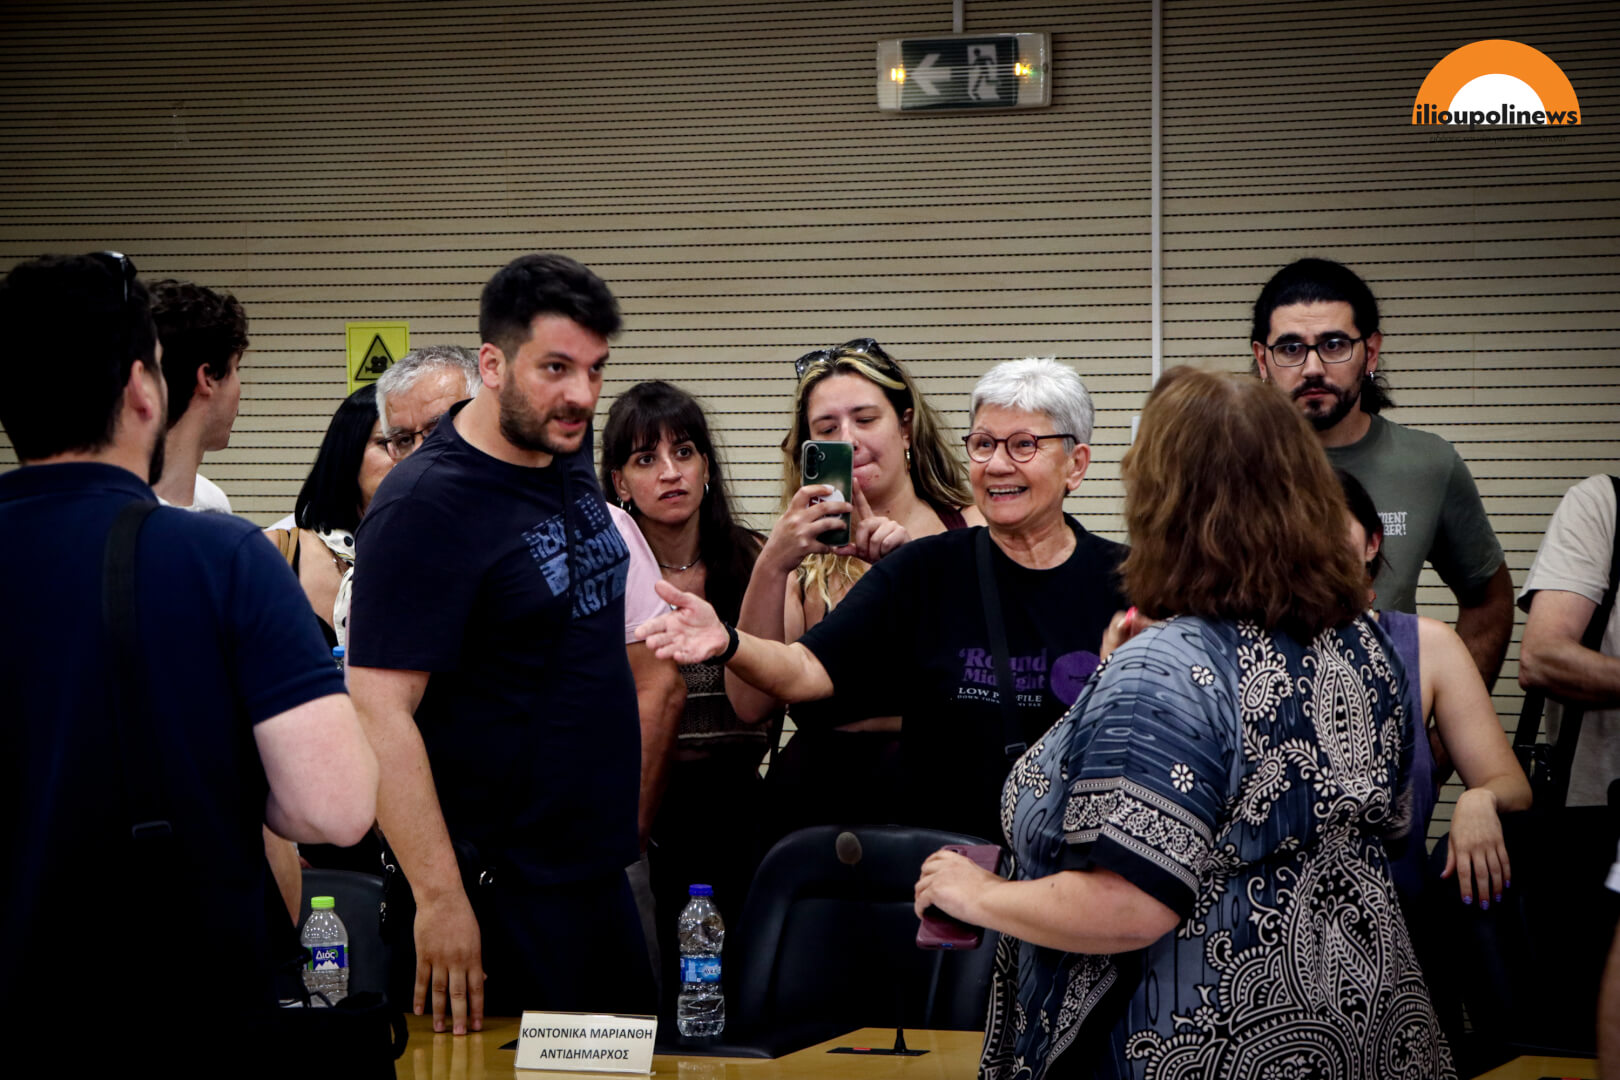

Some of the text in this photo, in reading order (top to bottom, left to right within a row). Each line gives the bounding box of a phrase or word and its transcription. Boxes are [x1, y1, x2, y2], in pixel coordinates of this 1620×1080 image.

[958, 687, 1042, 702] LOW PFILE
[315, 950, 336, 960] Διός
[522, 1027, 653, 1040] ΚΟΝΤΟΝΙΚΑ ΜΑΡΙΑΝΘΗ
[540, 1048, 630, 1060] ΑΝΤΙΔΗΜΑΡΧΟΣ
